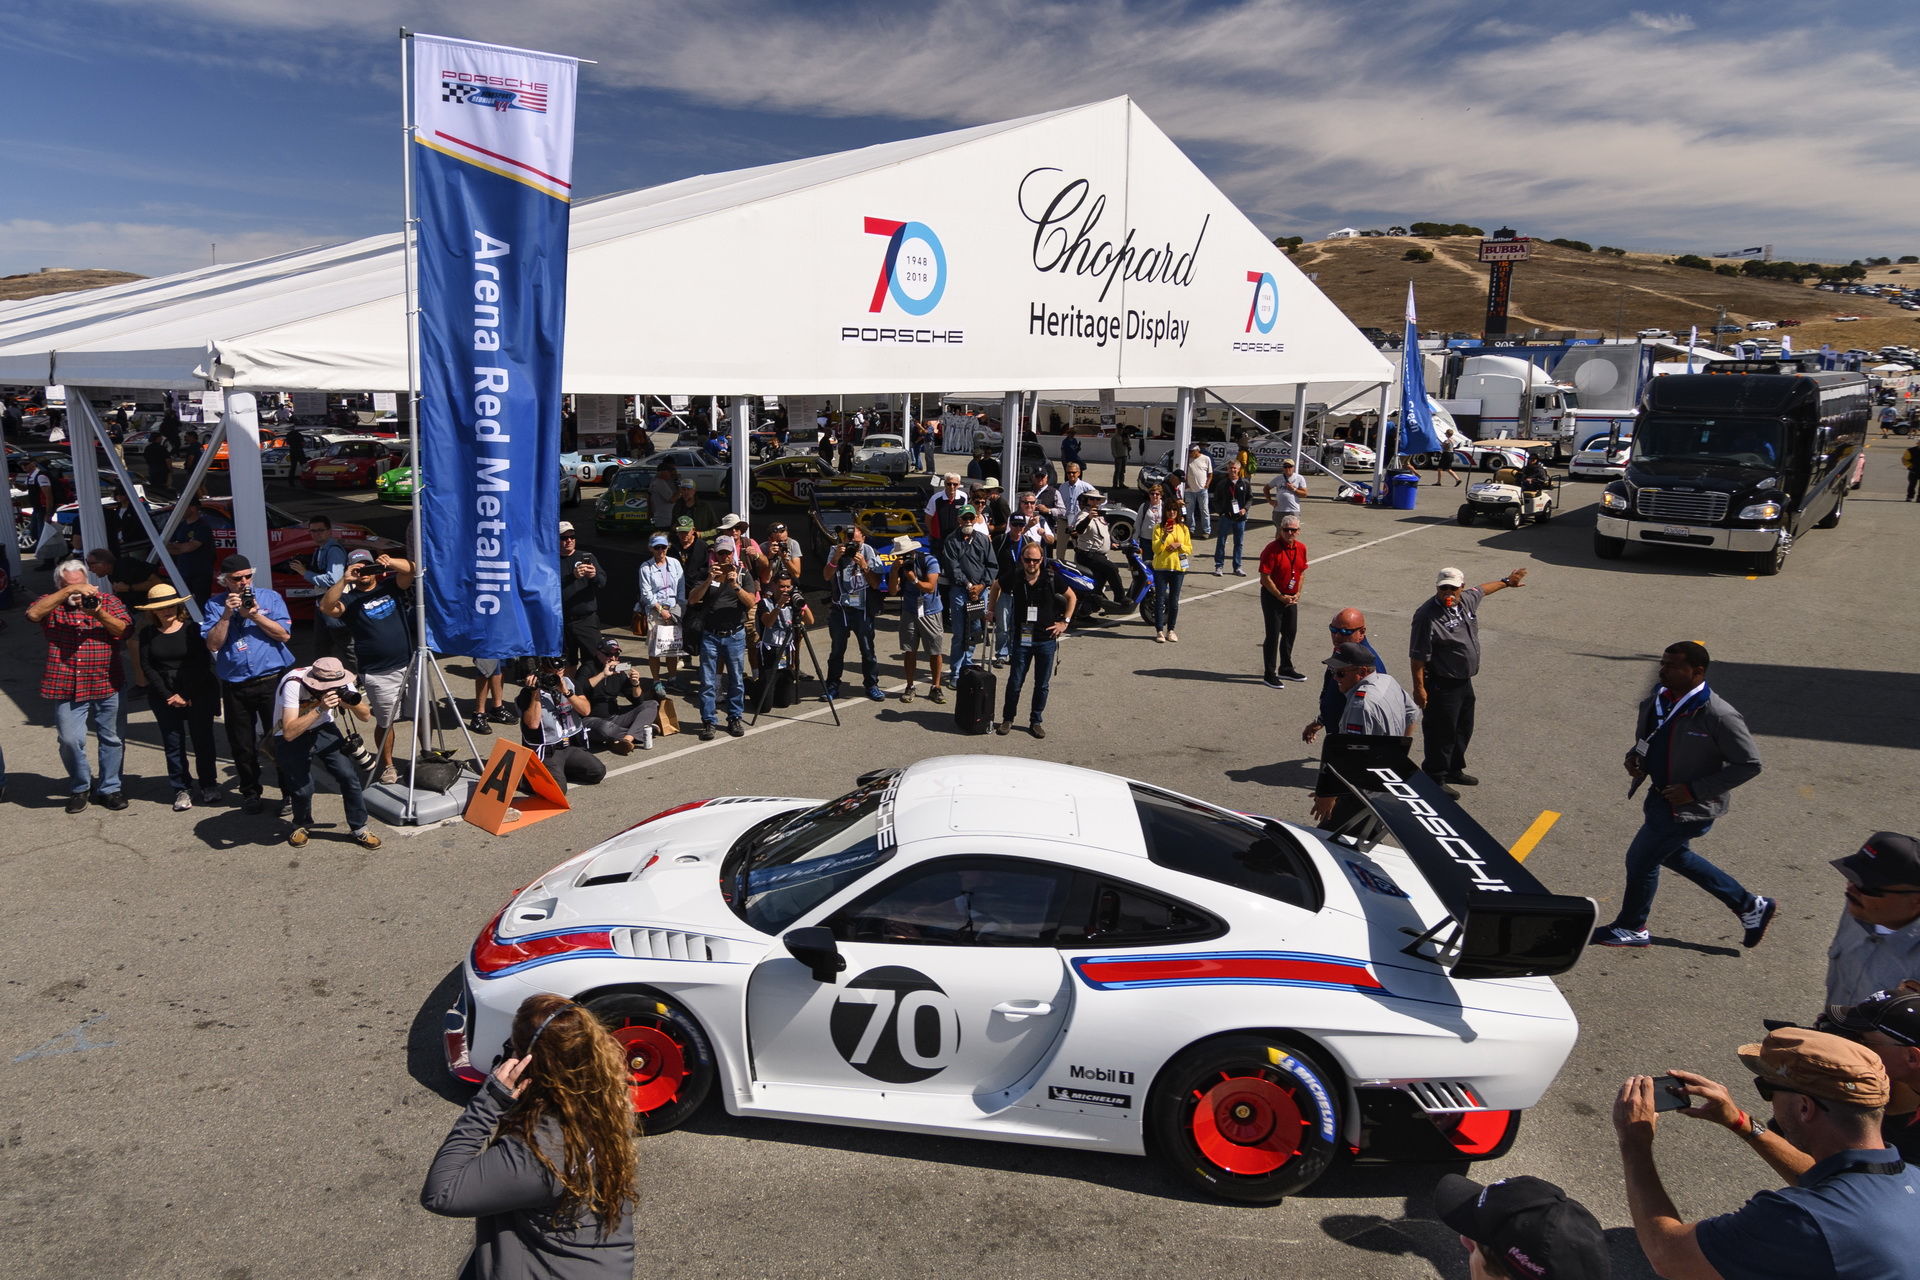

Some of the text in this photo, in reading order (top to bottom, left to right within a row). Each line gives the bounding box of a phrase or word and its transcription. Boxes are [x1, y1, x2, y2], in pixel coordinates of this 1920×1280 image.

[442, 70, 548, 92] PORSCHE
[495, 101, 511, 112] VI
[1018, 167, 1210, 302] Chopard
[1485, 245, 1526, 254] BUBBA
[863, 216, 947, 316] 70
[906, 256, 928, 266] 1948
[906, 272, 928, 282] 2018
[1245, 271, 1279, 334] 70
[1029, 302, 1190, 348] Heritage Display
[842, 327, 963, 343] PORSCHE
[1233, 342, 1284, 352] PORSCHE
[474, 229, 511, 616] Arena Red Metallic
[1212, 447, 1225, 458] 59
[582, 466, 591, 479] 9
[479, 749, 516, 804] A
[877, 766, 907, 851] ORSCHE
[838, 987, 957, 1069] 70
[1070, 1065, 1116, 1082] Mobil
[1071, 1093, 1125, 1104] MICHELIN
[1293, 1066, 1334, 1136] MICHELIN
